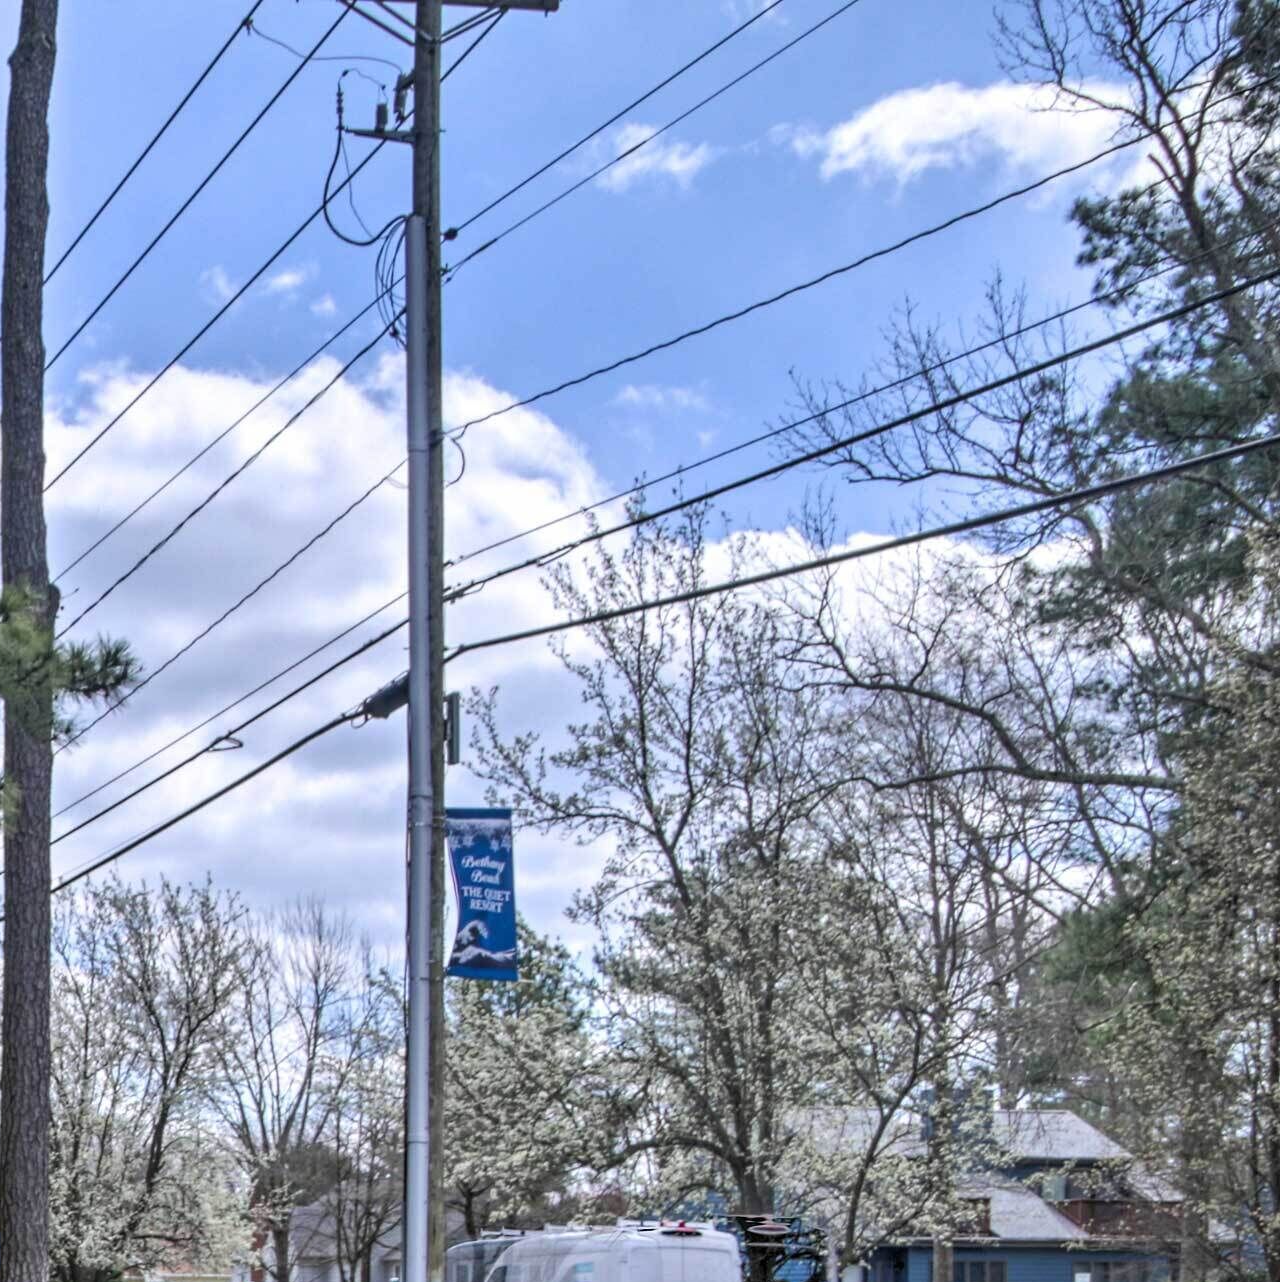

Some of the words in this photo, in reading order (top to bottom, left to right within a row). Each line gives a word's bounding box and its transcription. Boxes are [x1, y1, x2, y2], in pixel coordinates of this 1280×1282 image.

[461, 855, 506, 873] Bethany
[461, 886, 483, 898] THE
[484, 888, 511, 902] QUIET
